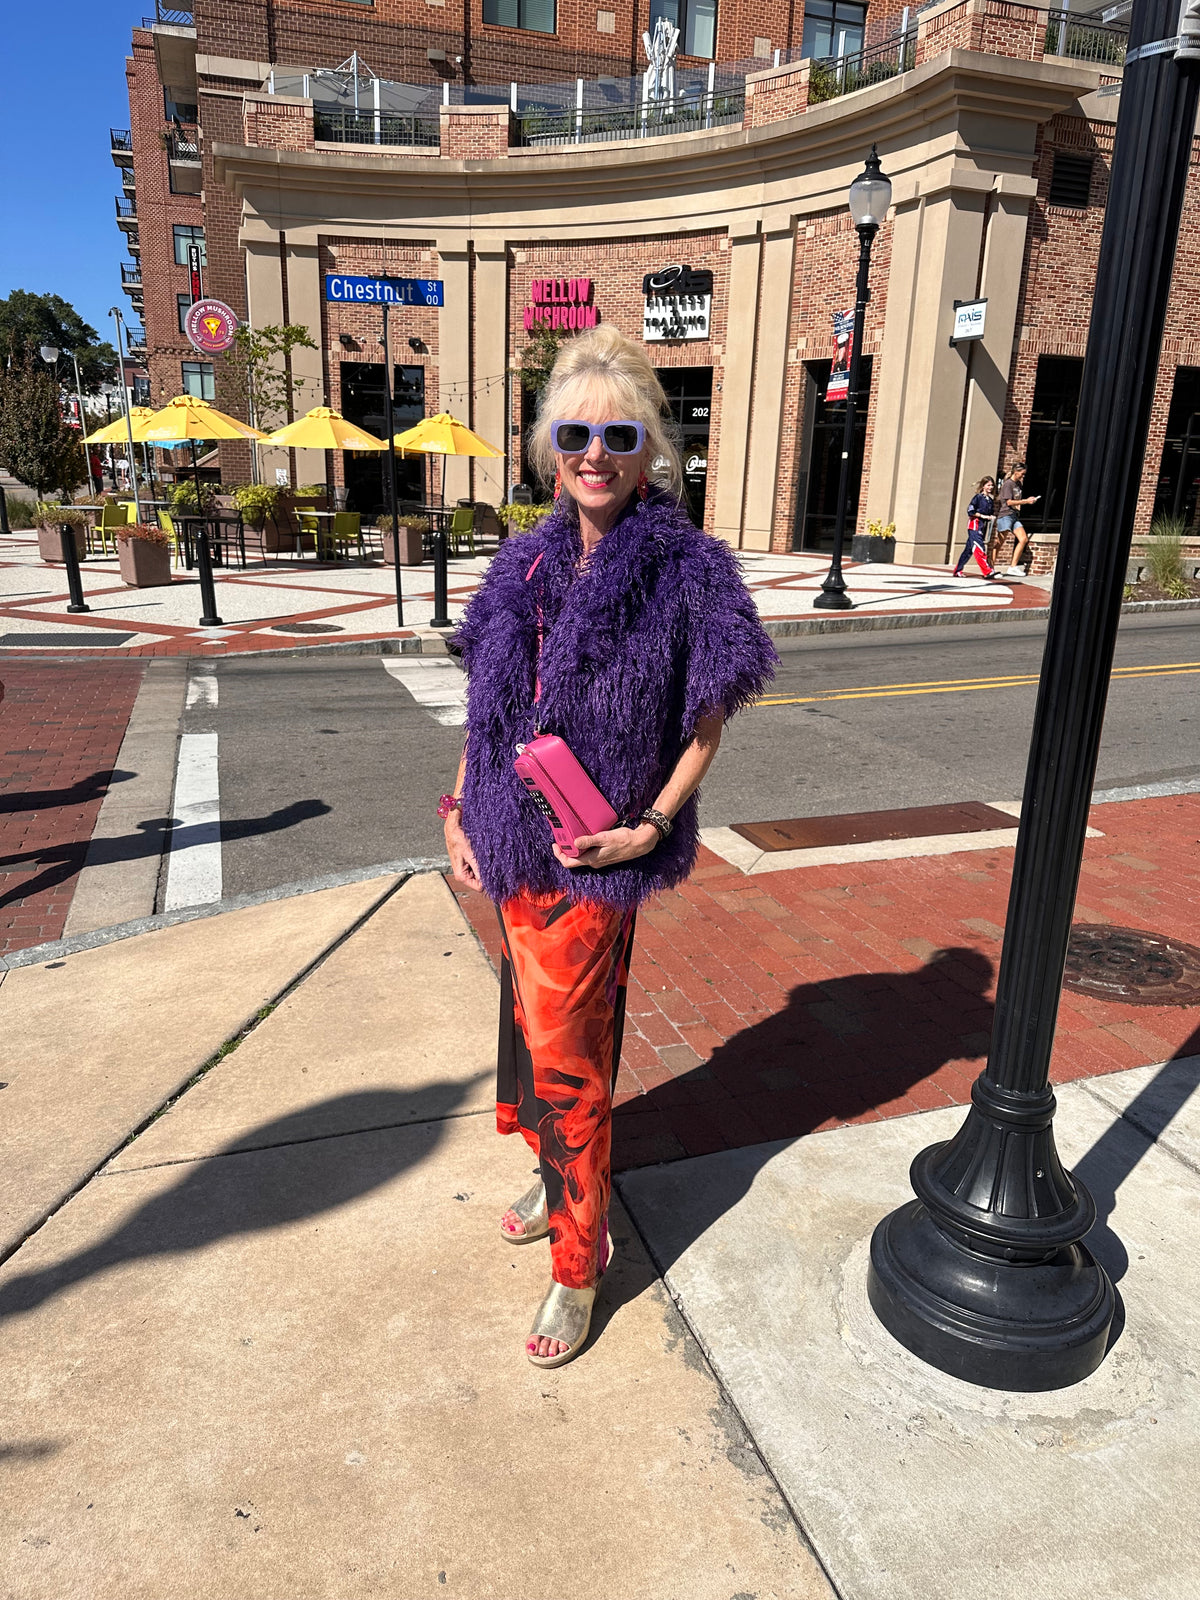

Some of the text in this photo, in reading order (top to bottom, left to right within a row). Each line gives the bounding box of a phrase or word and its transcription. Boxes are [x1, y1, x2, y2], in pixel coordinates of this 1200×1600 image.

[330, 278, 437, 302] Chestnut St
[532, 278, 590, 303] MELLOW
[191, 305, 234, 337] MELLOW MUSHROOM
[523, 306, 598, 330] MUSHROOM
[692, 408, 709, 417] 202
